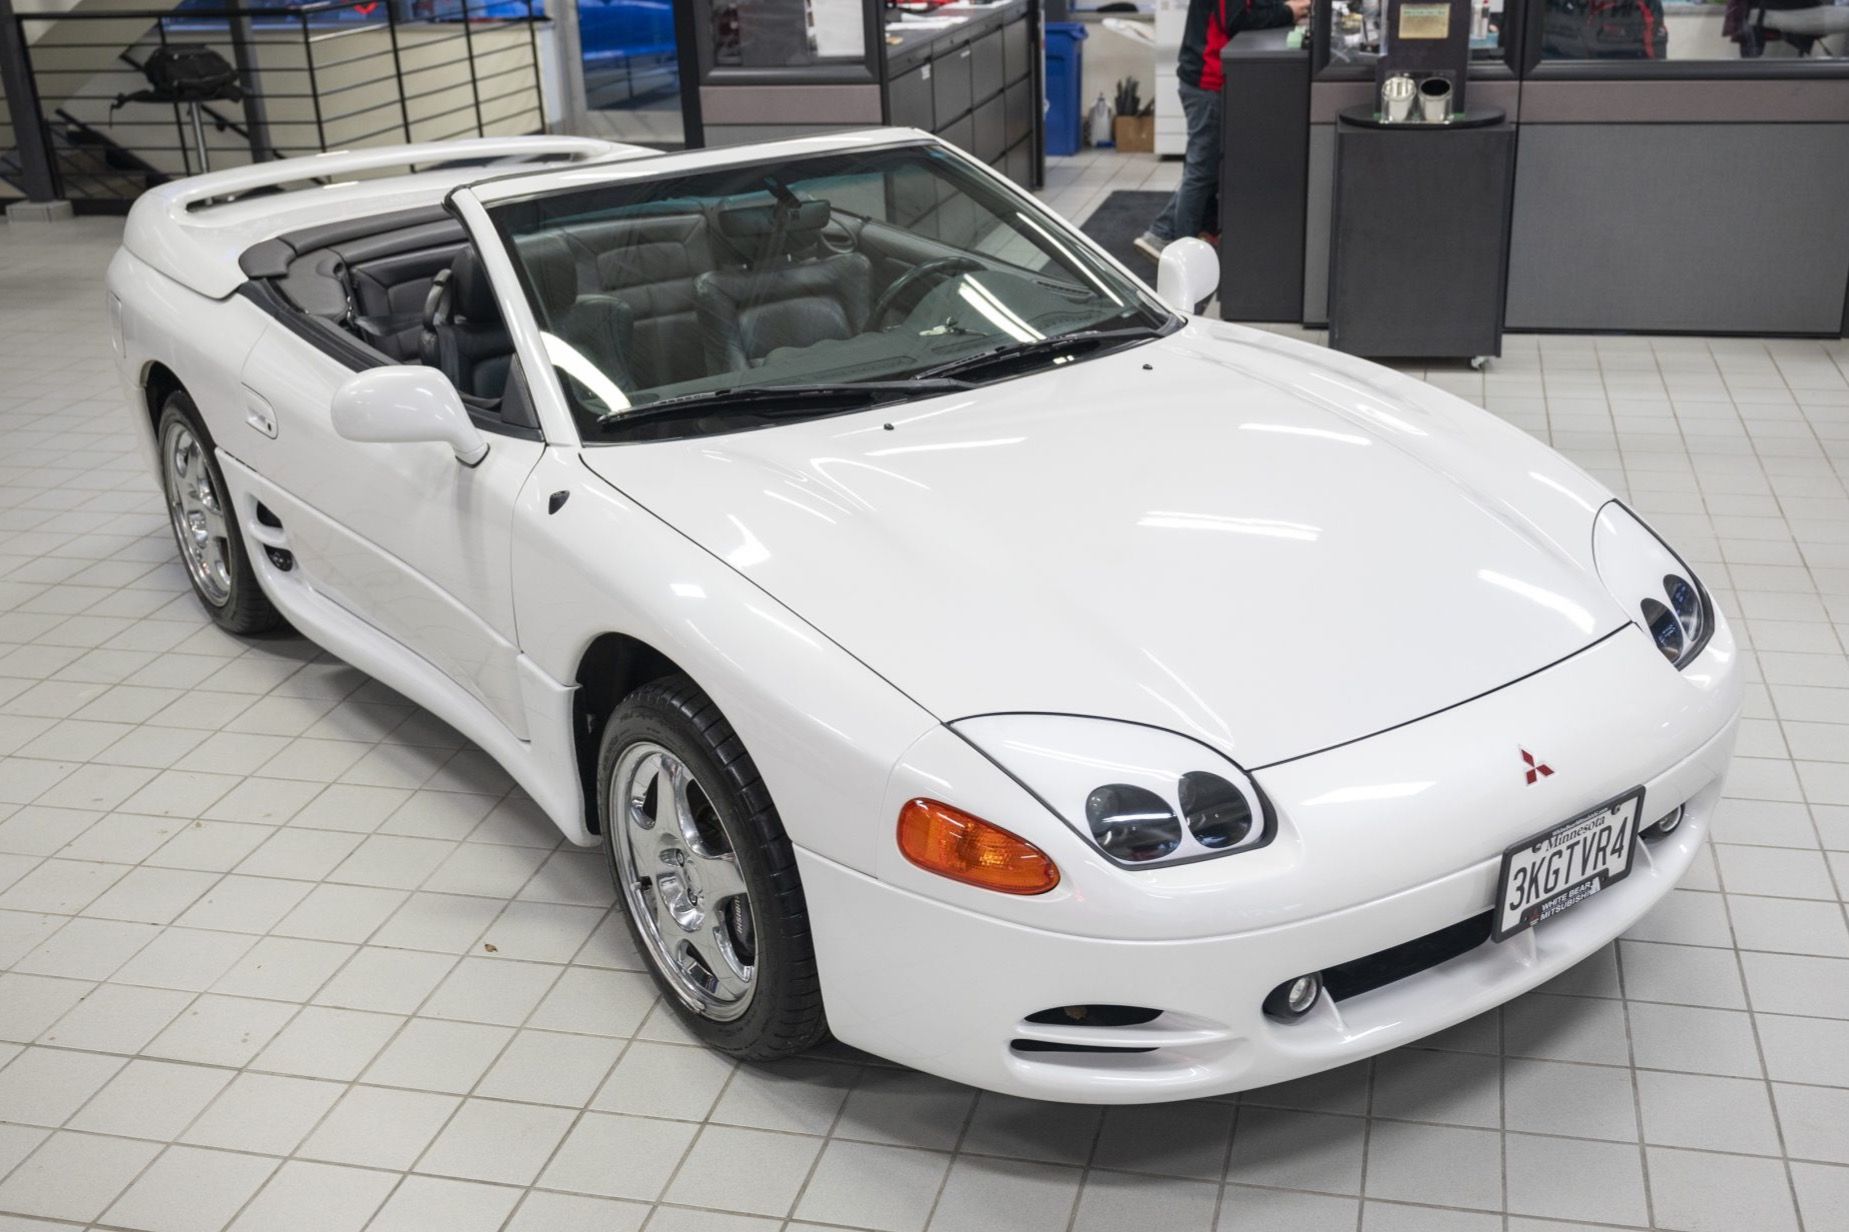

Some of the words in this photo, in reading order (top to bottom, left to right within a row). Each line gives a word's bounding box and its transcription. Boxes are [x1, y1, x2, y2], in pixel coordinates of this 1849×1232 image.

[1545, 816, 1605, 852] Minnesota
[1509, 816, 1628, 911] 3KGTVR4
[1541, 893, 1569, 911] WHITE
[1568, 881, 1592, 898] BEAR
